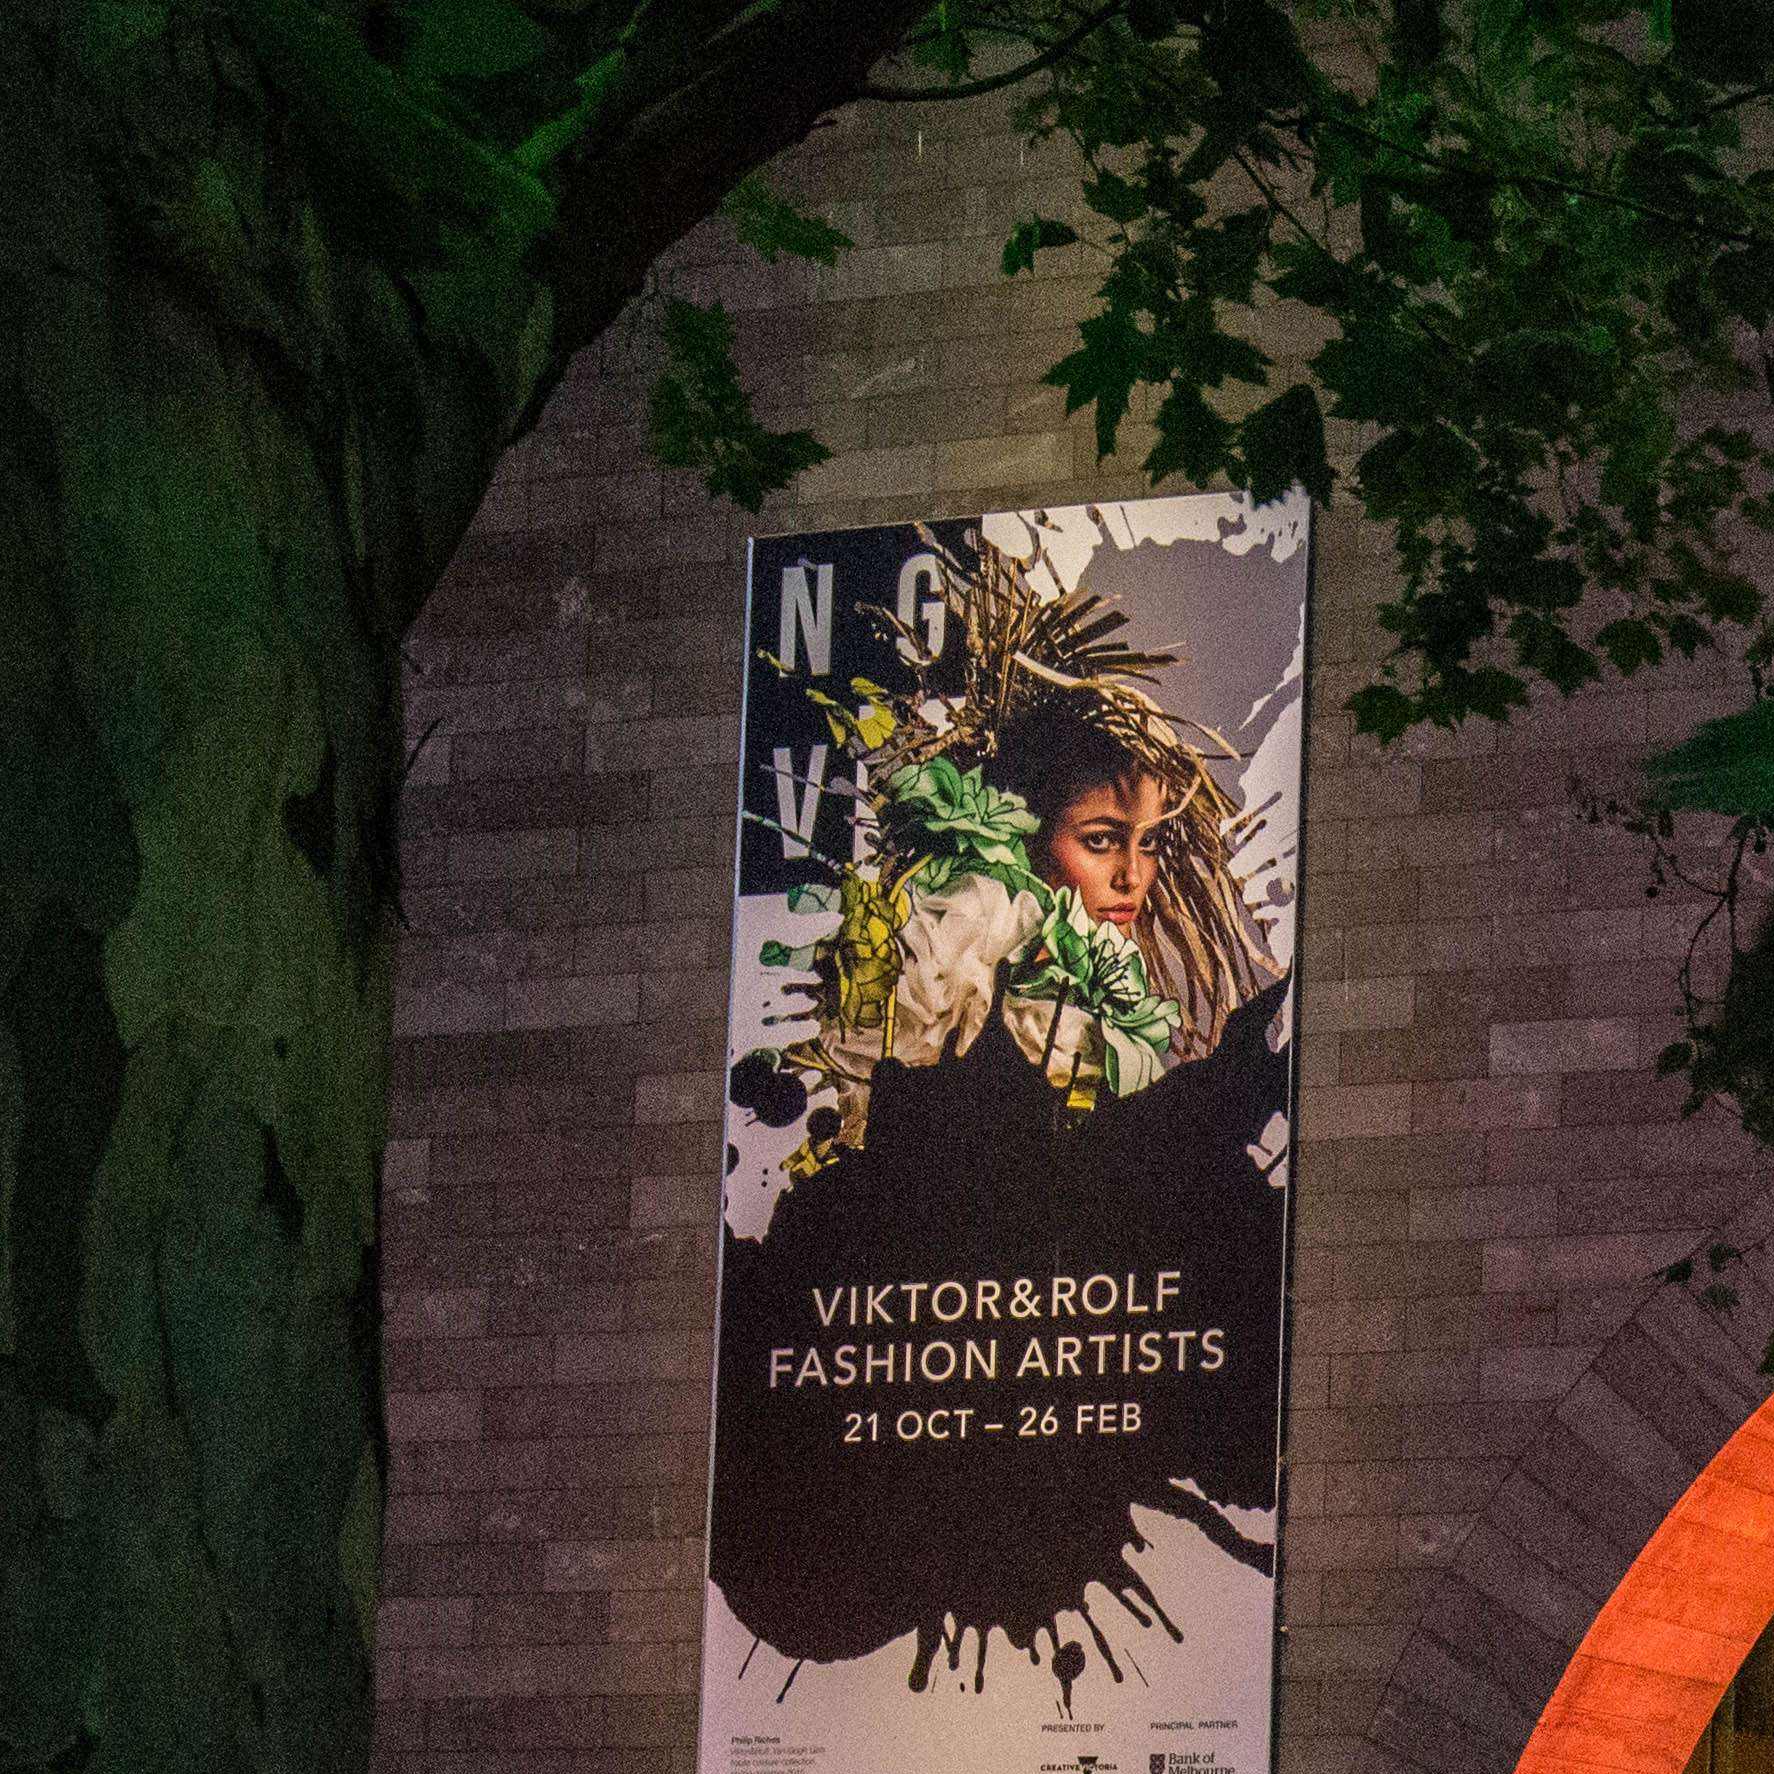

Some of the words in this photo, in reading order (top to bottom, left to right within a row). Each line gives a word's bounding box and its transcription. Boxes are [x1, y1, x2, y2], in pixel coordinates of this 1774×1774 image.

[812, 1271, 1181, 1326] VIKTOR&ROLF
[769, 1339, 997, 1388] FASHION
[1016, 1328, 1226, 1378] ARTISTS
[844, 1412, 878, 1442] 21
[896, 1408, 975, 1440] OCT
[1018, 1405, 1059, 1437] 26
[1076, 1402, 1142, 1434] FEB
[1041, 1723, 1092, 1733] PRESENTED
[1093, 1723, 1105, 1732] BY
[1150, 1721, 1194, 1731] PRINCIPAL
[1198, 1720, 1239, 1730] PARTNER
[1168, 1752, 1200, 1765] Bank
[1202, 1751, 1216, 1764] of
